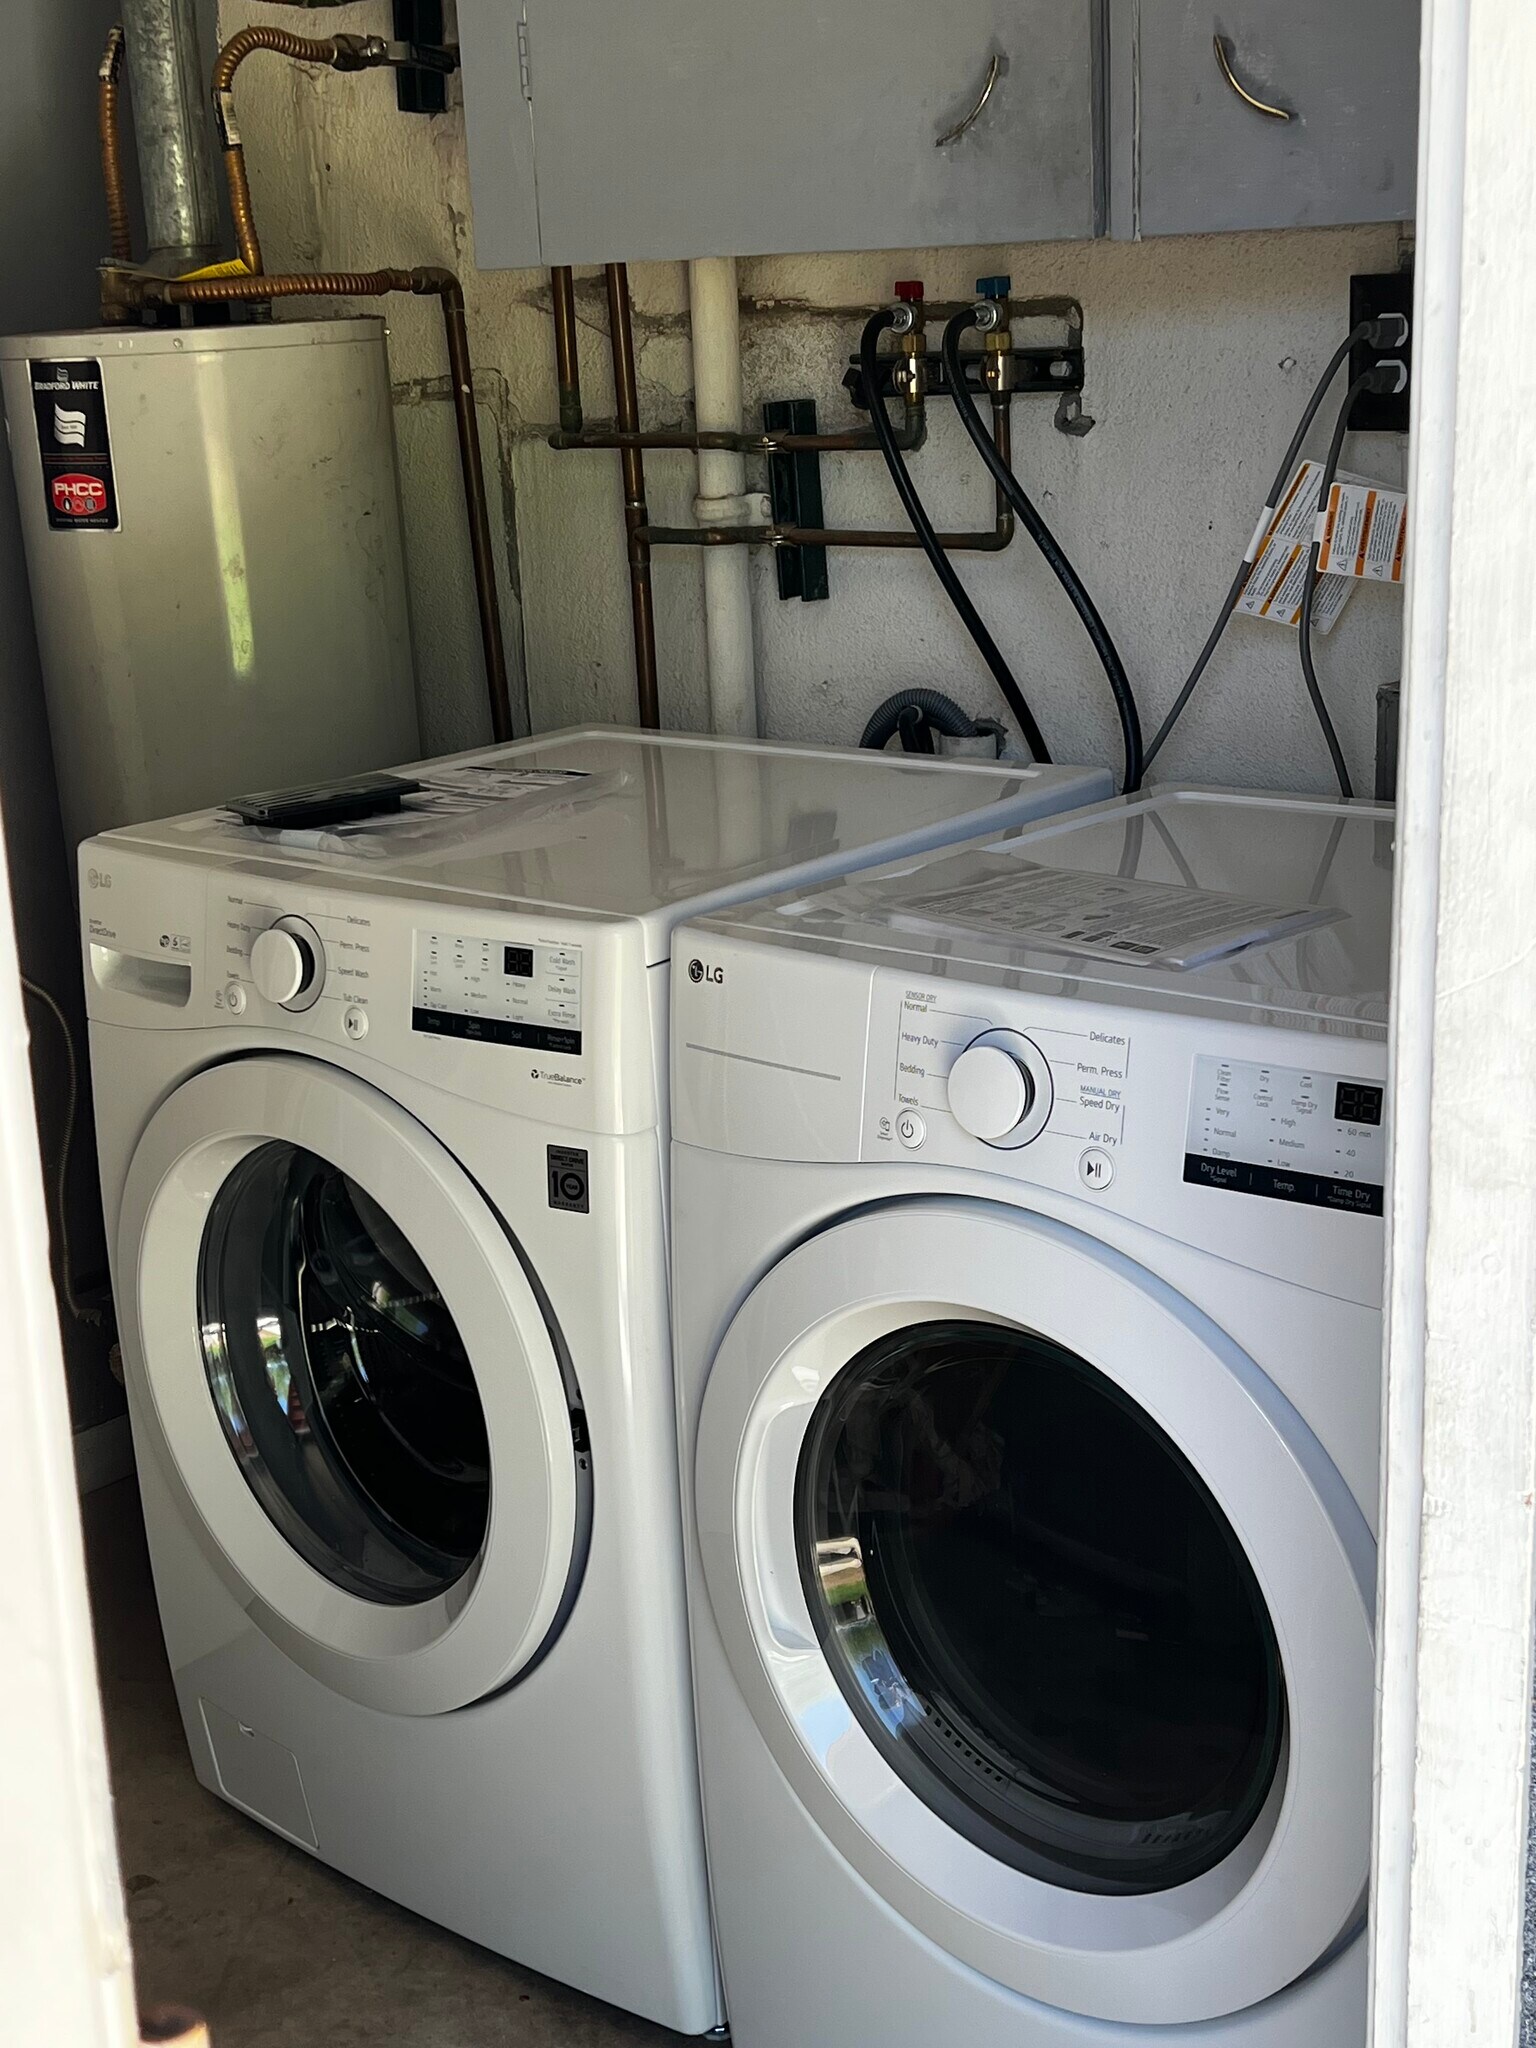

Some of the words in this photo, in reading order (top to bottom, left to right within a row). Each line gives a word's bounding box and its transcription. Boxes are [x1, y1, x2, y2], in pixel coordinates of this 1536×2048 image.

[33, 381, 71, 391] BRADFORD
[71, 380, 100, 390] WHITE
[54, 482, 103, 496] PHCC
[99, 872, 112, 889] LG
[346, 915, 371, 927] Delicates
[705, 964, 724, 984] LG
[905, 990, 926, 1000] SENSOR
[926, 993, 938, 1002] DRY
[903, 1001, 928, 1013] Normal
[901, 1032, 921, 1045] Heavy
[922, 1035, 939, 1048] Duty
[1089, 1031, 1126, 1046] Delicates
[899, 1062, 926, 1077] Bedding
[1076, 1062, 1099, 1076] Perm.
[1100, 1066, 1123, 1079] Press
[1259, 1074, 1270, 1083] Dry
[1299, 1080, 1313, 1089] Cool
[1080, 1085, 1106, 1096] MANUAL
[1108, 1089, 1121, 1099] DRY
[1253, 1093, 1274, 1102] Control
[898, 1093, 919, 1106] Towels
[1079, 1096, 1104, 1109] Speed
[1105, 1100, 1121, 1114] Dry
[1307, 1102, 1318, 1110] Dry
[1215, 1107, 1231, 1118] Very
[1280, 1117, 1297, 1128] High
[1213, 1127, 1237, 1138] Normal
[1347, 1128, 1357, 1137] 60
[1358, 1130, 1372, 1138] min
[1088, 1131, 1101, 1142] Air
[1103, 1133, 1118, 1147] Dry
[1278, 1138, 1306, 1149] Medium
[1212, 1148, 1231, 1159] Damp
[1345, 1149, 1356, 1158] 40
[1277, 1159, 1291, 1168] Low
[1200, 1162, 1215, 1175] Dry
[1216, 1165, 1238, 1178] Level
[1344, 1170, 1354, 1179] 20
[1272, 1178, 1296, 1193] Temp.
[1332, 1184, 1353, 1198] Time
[1354, 1189, 1371, 1202] Dry
